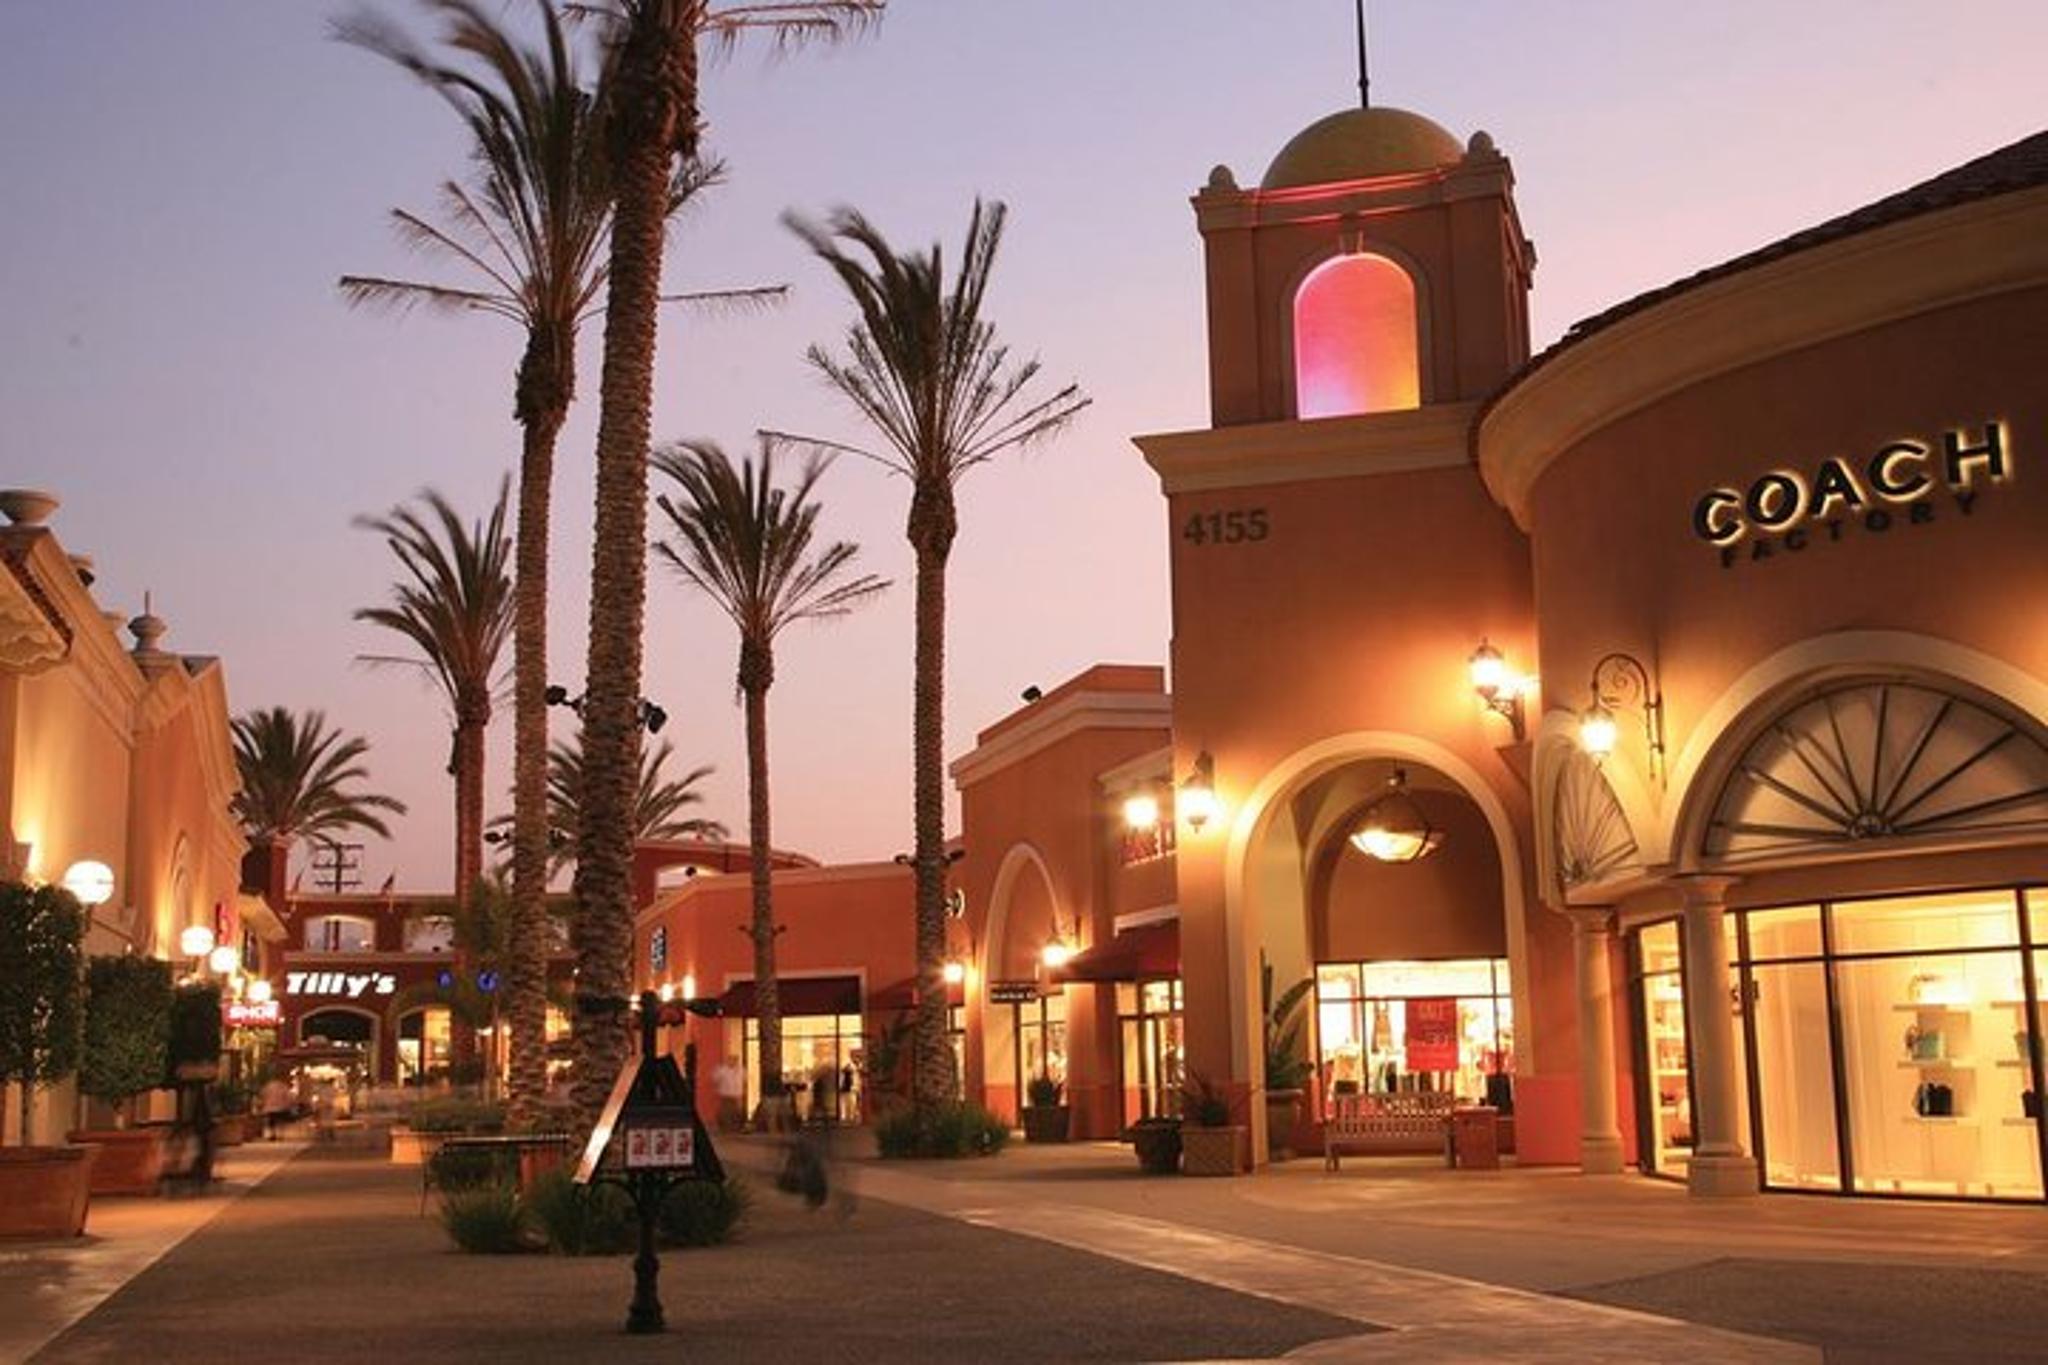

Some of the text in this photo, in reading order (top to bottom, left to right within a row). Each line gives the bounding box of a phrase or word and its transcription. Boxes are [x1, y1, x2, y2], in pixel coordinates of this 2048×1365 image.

[1694, 421, 2011, 545] COACH
[1184, 510, 1270, 545] 4155
[1719, 492, 1975, 570] FACTORY
[286, 972, 396, 997] Tilly's
